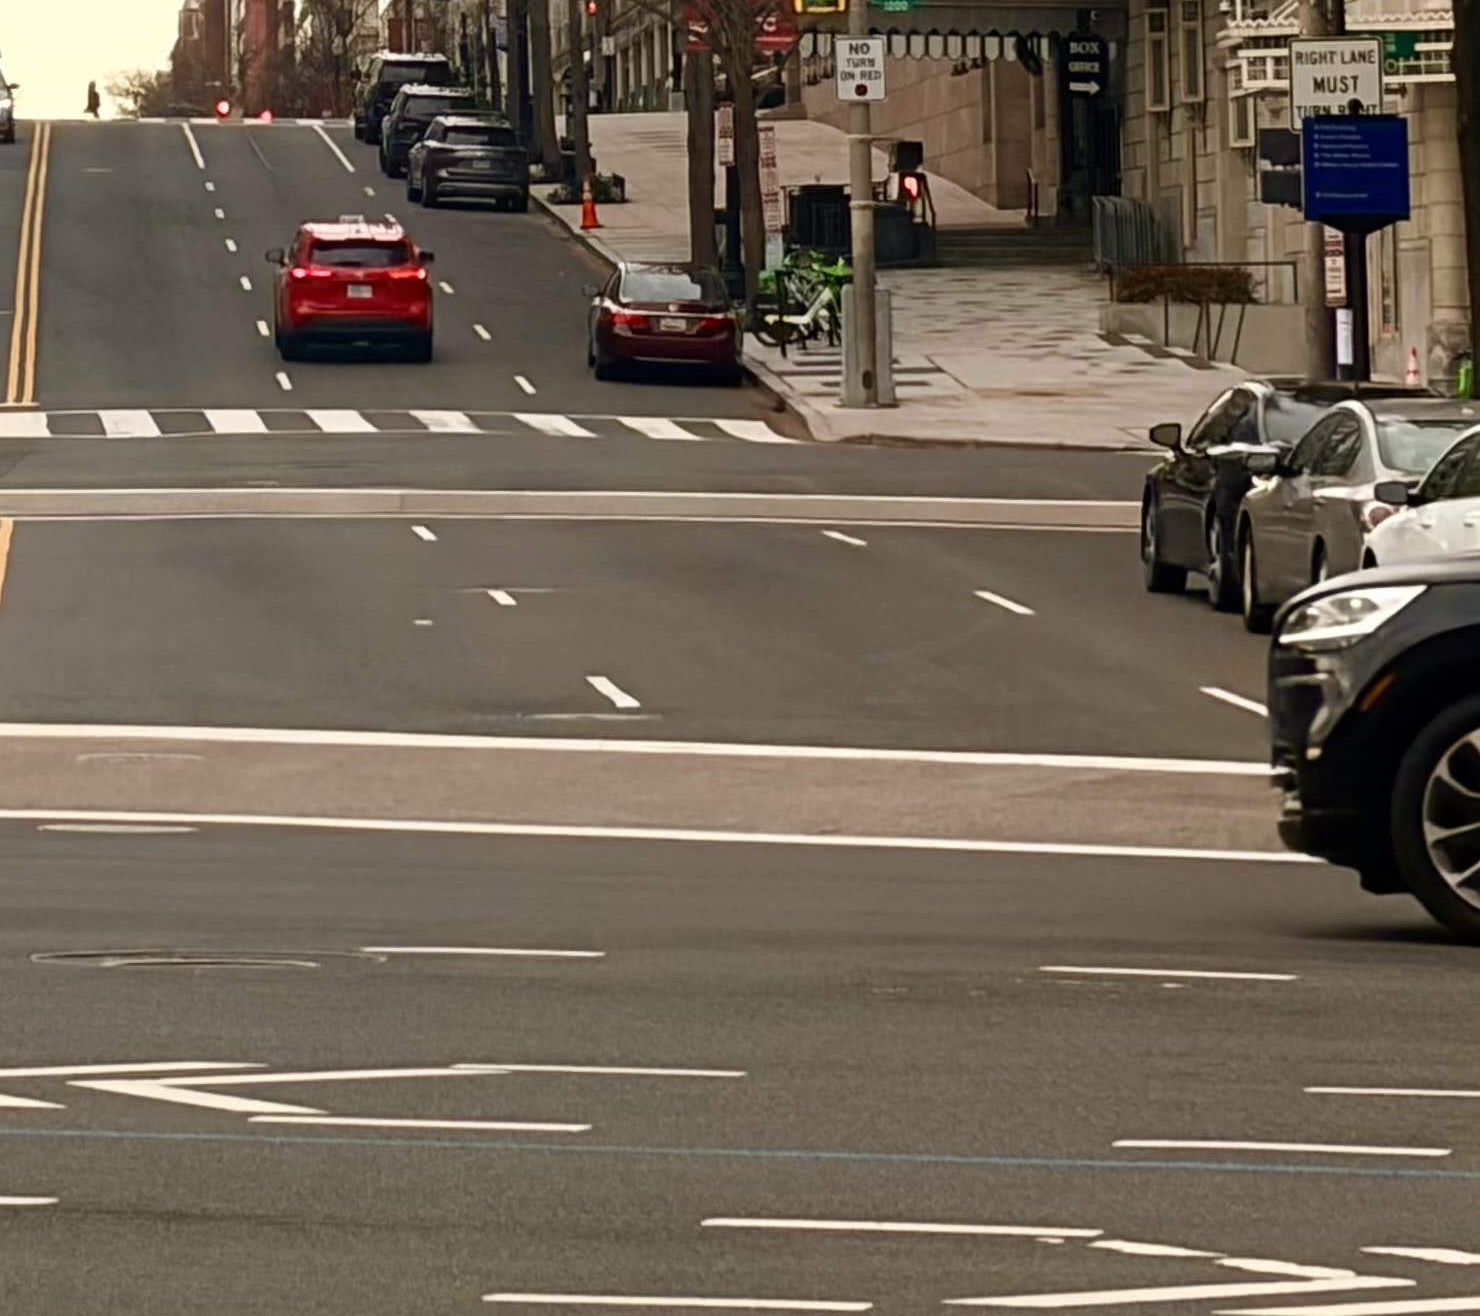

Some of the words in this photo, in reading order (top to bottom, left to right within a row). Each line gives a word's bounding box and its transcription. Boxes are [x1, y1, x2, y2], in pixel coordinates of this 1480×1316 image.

[849, 42, 870, 55] NO
[1069, 41, 1100, 54] BOX
[846, 57, 876, 69] TURN
[1295, 50, 1337, 66] RIGHT
[1340, 49, 1376, 65] LANE
[840, 70, 856, 82] ON
[859, 70, 882, 81] RED
[1312, 75, 1360, 94] MUST
